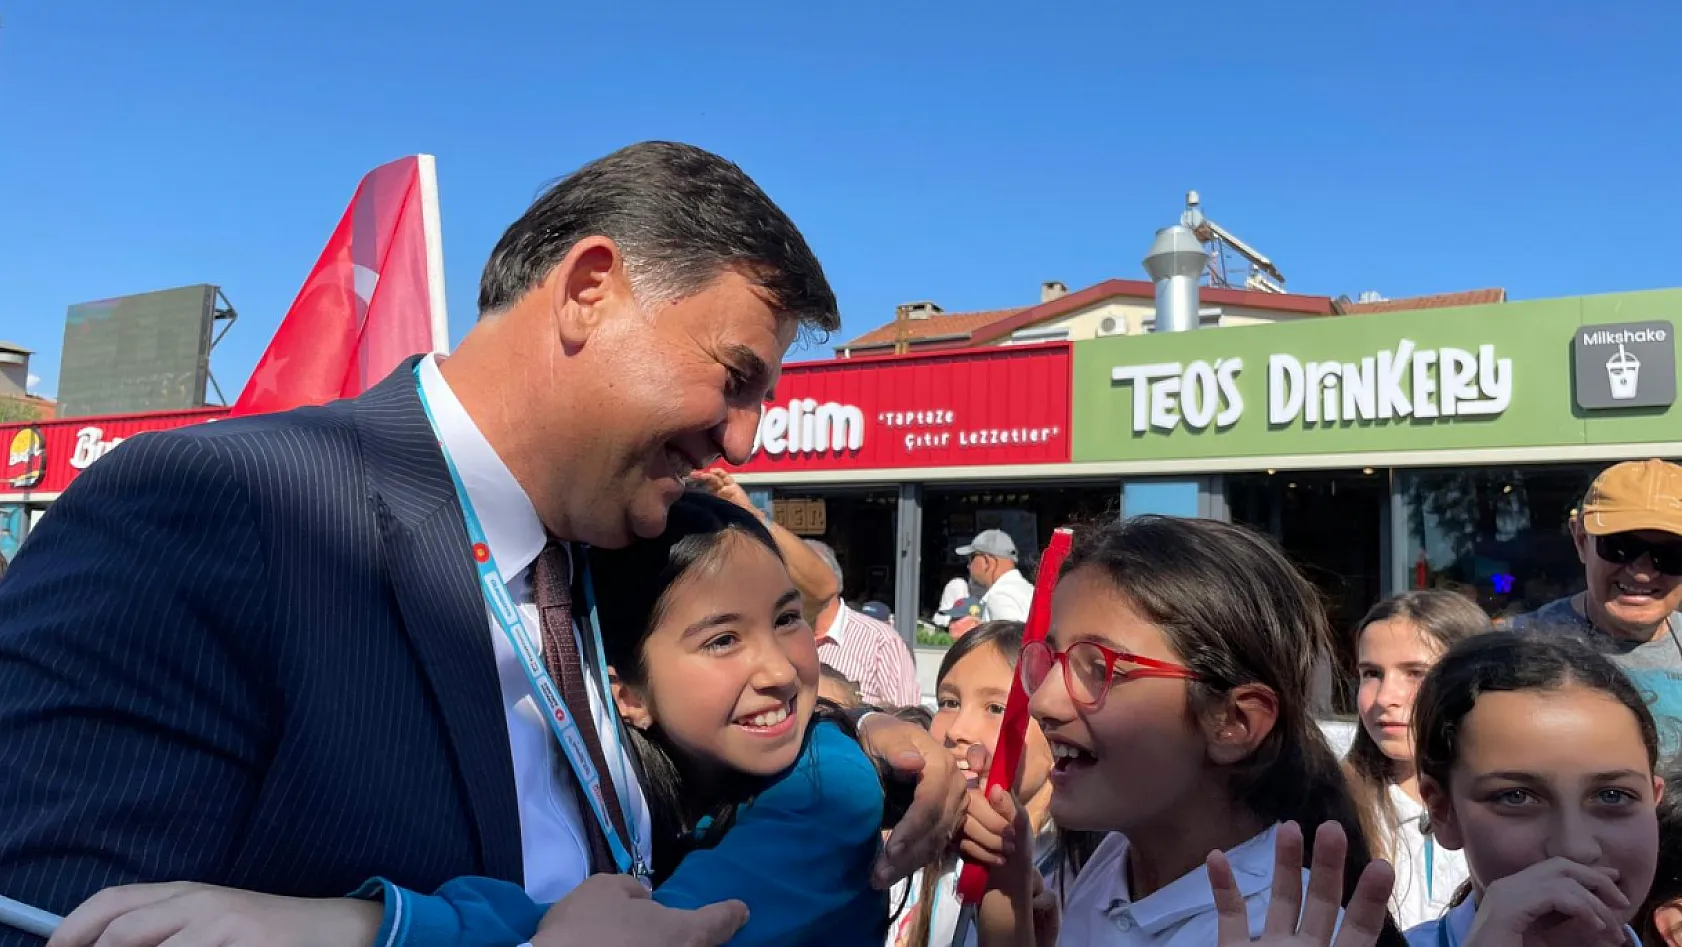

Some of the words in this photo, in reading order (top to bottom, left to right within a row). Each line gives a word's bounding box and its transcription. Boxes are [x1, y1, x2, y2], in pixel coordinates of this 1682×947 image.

[1583, 328, 1666, 345] Milkshake
[1112, 357, 1244, 431] TEO'S
[751, 397, 865, 455] elim
